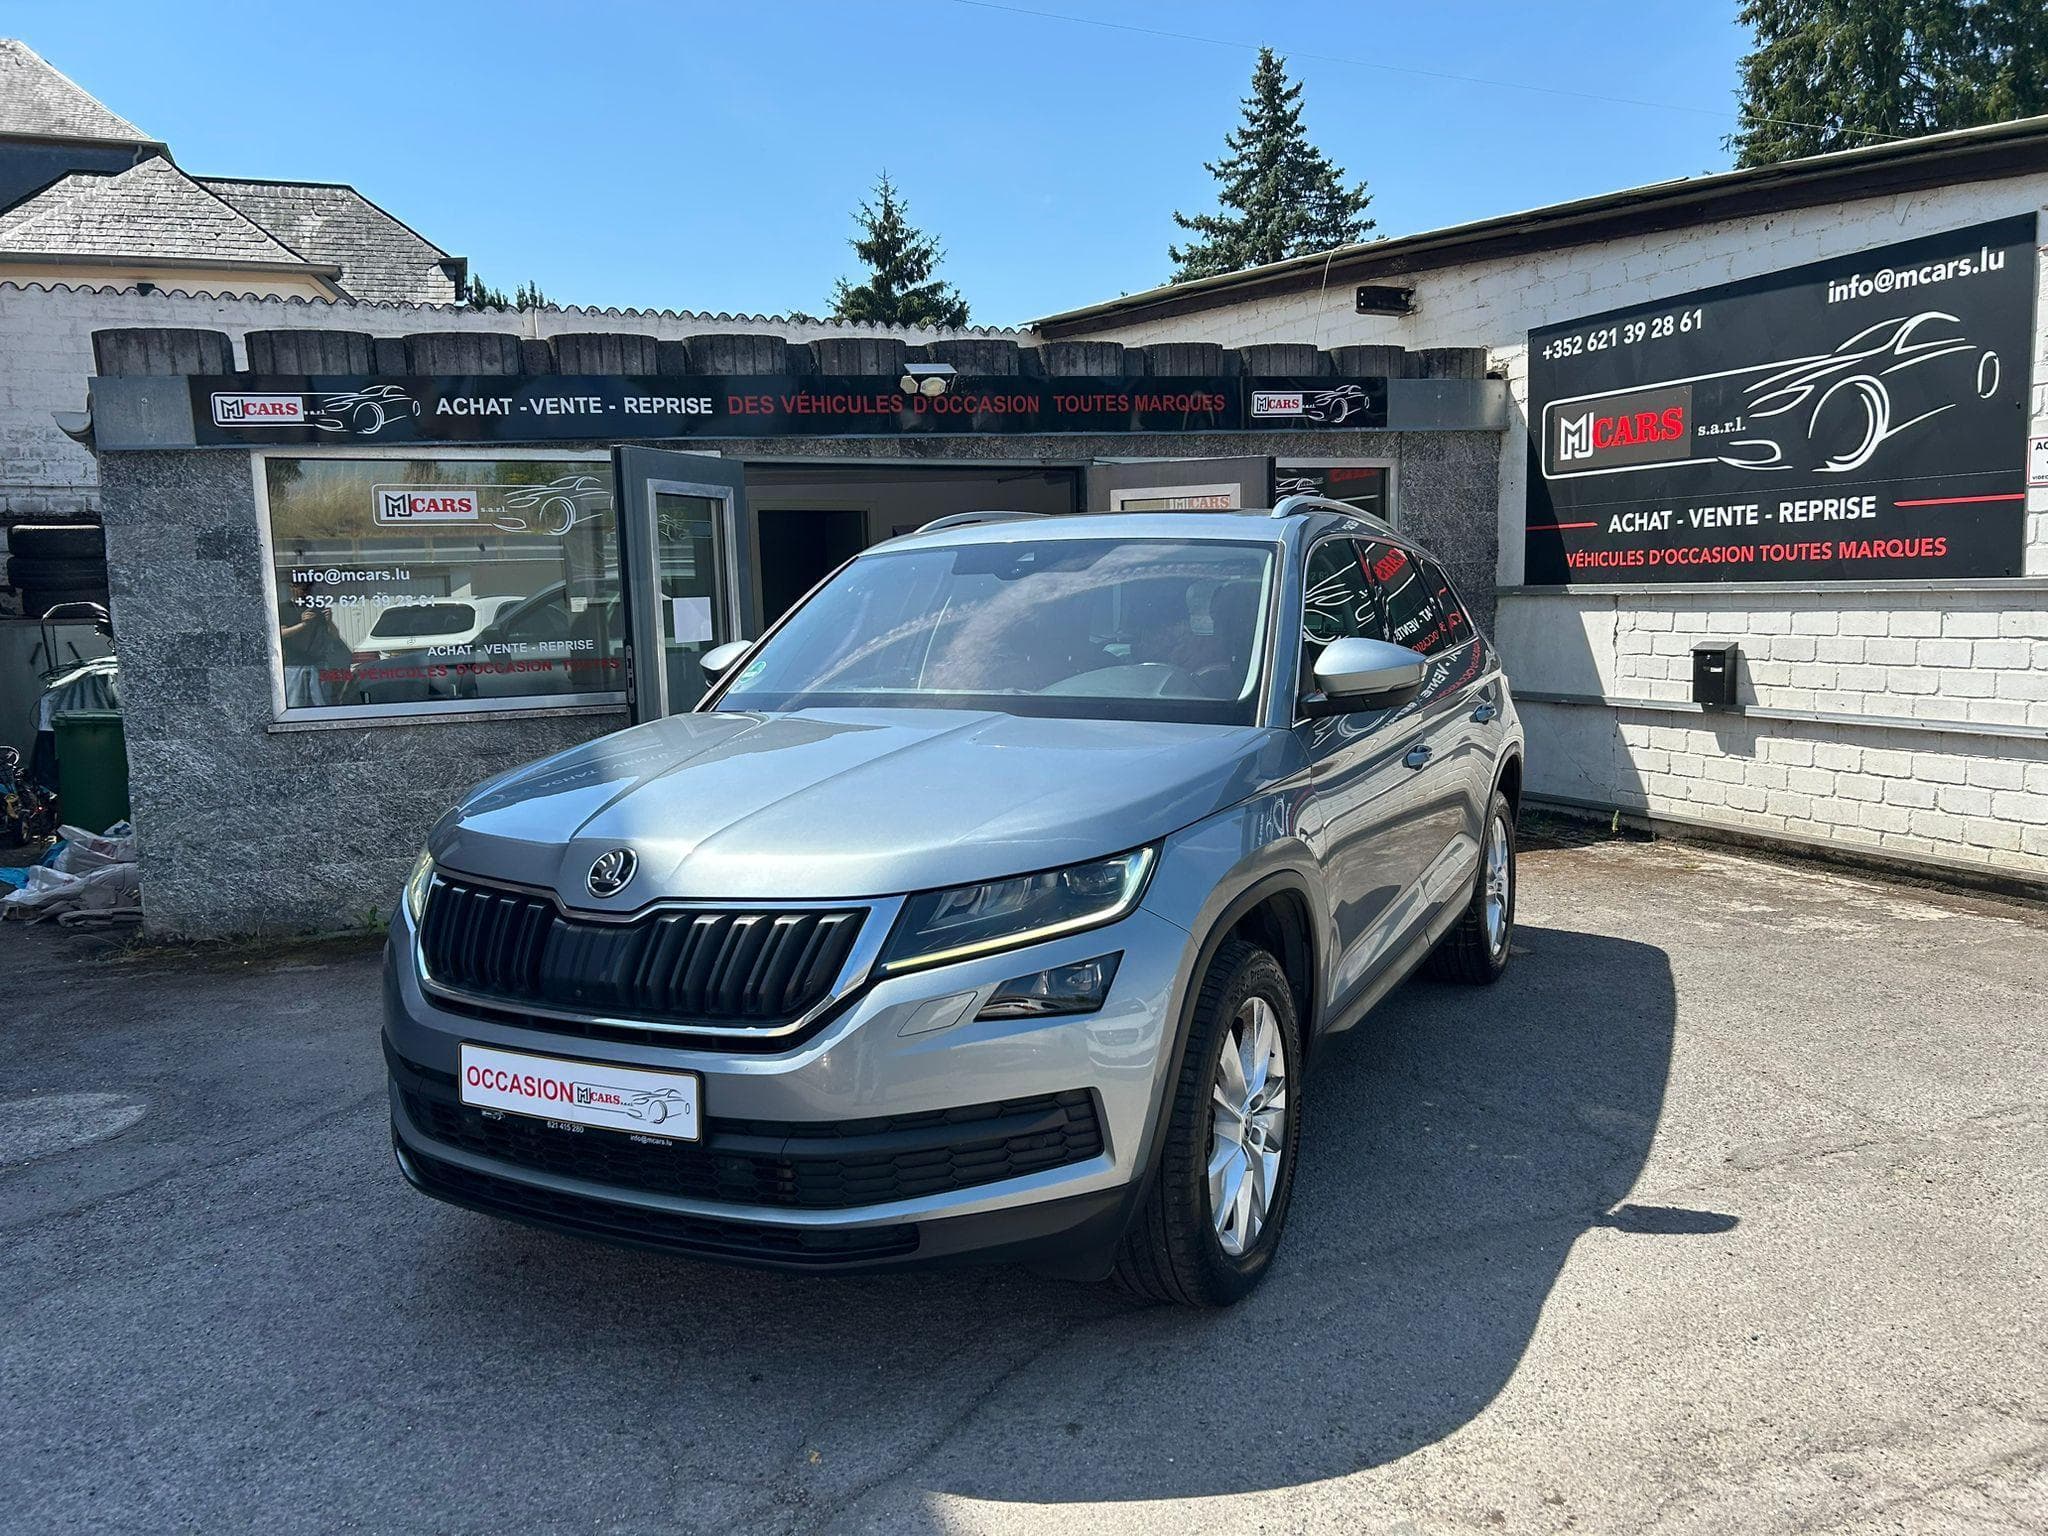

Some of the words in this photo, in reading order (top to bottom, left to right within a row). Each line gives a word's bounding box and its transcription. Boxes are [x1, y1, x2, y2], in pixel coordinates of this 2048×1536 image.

[1827, 247, 2005, 304] info@mcars.lu
[1542, 335, 1583, 361] +352
[1587, 327, 1619, 351] 621
[1623, 322, 1647, 345] 39
[1651, 315, 1676, 337] 28
[1680, 308, 1703, 331] 61
[435, 398, 512, 415] ACHAT
[529, 397, 603, 414] VENTE
[624, 397, 713, 414] REPRISE
[728, 396, 774, 414] DES
[784, 391, 902, 414] VÉHICULES
[913, 395, 1039, 414] D'OCCASION
[1054, 395, 1129, 413] TOUTES
[1135, 394, 1225, 413] MARQUES
[1608, 510, 1672, 533] ACHAT
[1688, 504, 1759, 528] VENTE
[1779, 496, 1876, 523] REPRISE
[1566, 549, 1644, 568] VÉHICULES
[1760, 543, 1832, 562] TOUTES
[1838, 537, 1947, 559] MARQUES
[292, 568, 410, 584] info@mcars.lu
[295, 595, 333, 608] +352
[339, 595, 366, 607] 621
[427, 647, 472, 656] ACHAT
[484, 644, 527, 654] VENTE
[539, 640, 594, 651] REPRISE
[467, 1066, 573, 1103] OCCASION
